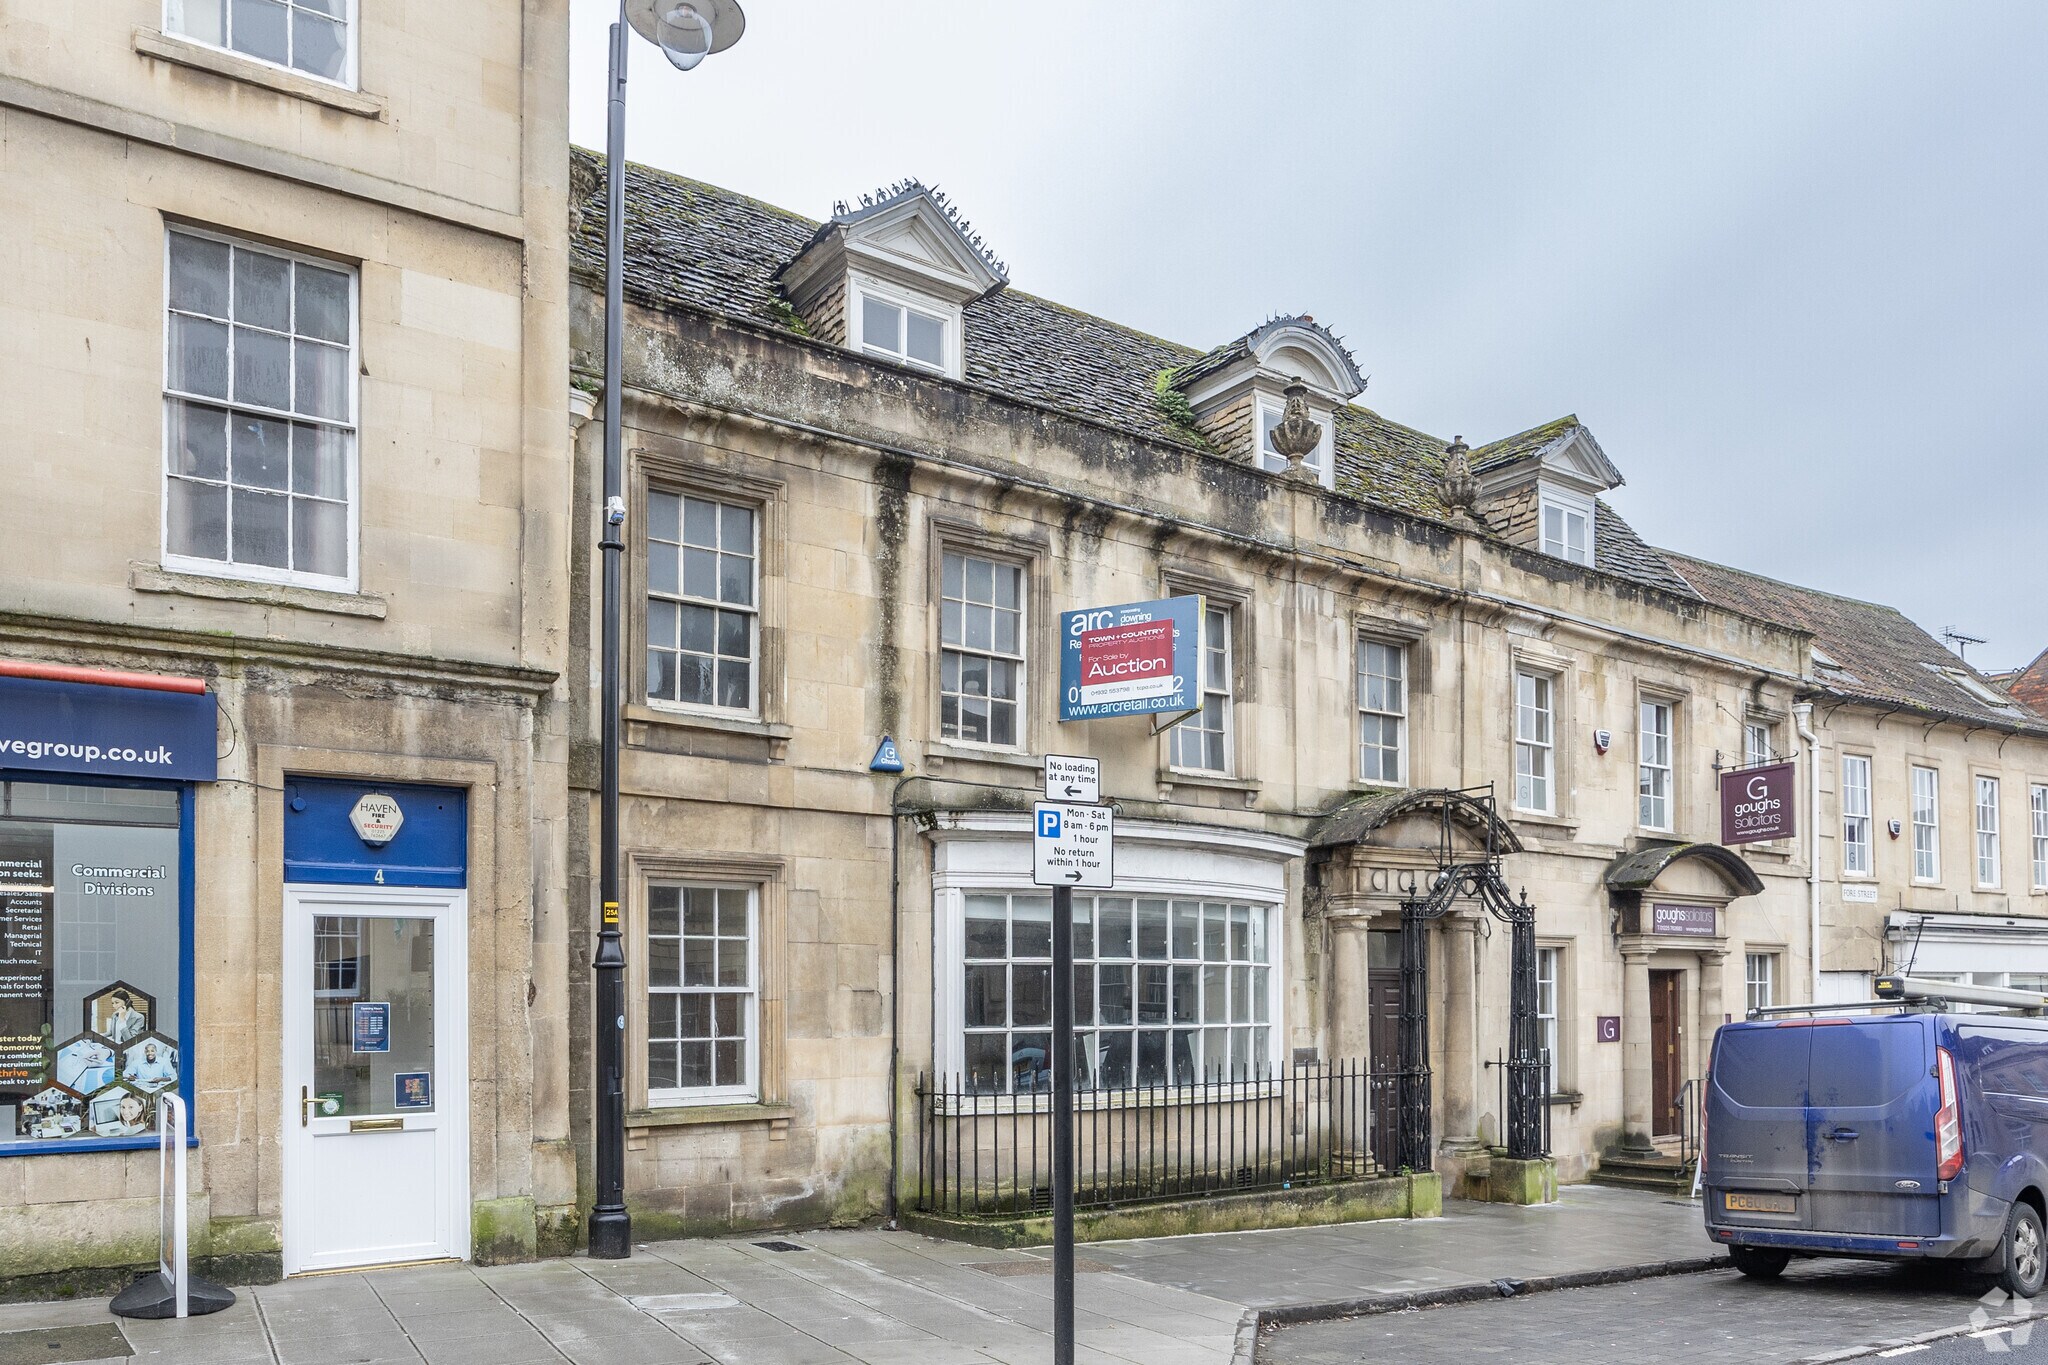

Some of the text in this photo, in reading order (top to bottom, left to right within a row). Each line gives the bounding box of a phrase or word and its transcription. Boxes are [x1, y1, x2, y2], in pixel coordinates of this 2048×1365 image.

[1070, 610, 1114, 636] arc
[1120, 611, 1152, 623] downing
[1088, 634, 1115, 644] TOWN
[1121, 627, 1166, 639] COUNTRY
[1088, 638, 1128, 649] PROPERTY
[1128, 633, 1166, 644] AUCTIONS
[1088, 655, 1102, 663] For
[1103, 653, 1119, 662] Sale
[1119, 652, 1129, 661] by
[1088, 657, 1167, 678] Auction
[1068, 695, 1185, 716] www.arcretail.co.uk
[880, 757, 900, 766] Chubb
[1050, 762, 1095, 774] No loading
[1048, 773, 1096, 784] at any time
[1746, 776, 1768, 800] G
[360, 803, 397, 814] HAVEN
[1734, 798, 1781, 817] goughs
[1067, 808, 1085, 818] Mon
[1091, 810, 1106, 820] Sat
[1043, 813, 1058, 836] P
[1063, 820, 1069, 829] 8
[1089, 822, 1095, 831] 6
[1096, 824, 1109, 833] pm
[1734, 813, 1781, 829] solicitors
[1073, 834, 1098, 844] 1 hour
[1053, 847, 1094, 857] No return
[1047, 858, 1101, 868] within 1 hour
[12, 869, 43, 878] seeks:
[71, 863, 166, 879] Commercial
[374, 868, 385, 885] 4
[83, 881, 155, 897] Divisions
[9, 940, 42, 948] Technical
[1603, 1019, 1615, 1039] G
[17, 1034, 42, 1043] today
[26, 1077, 42, 1086] you!
